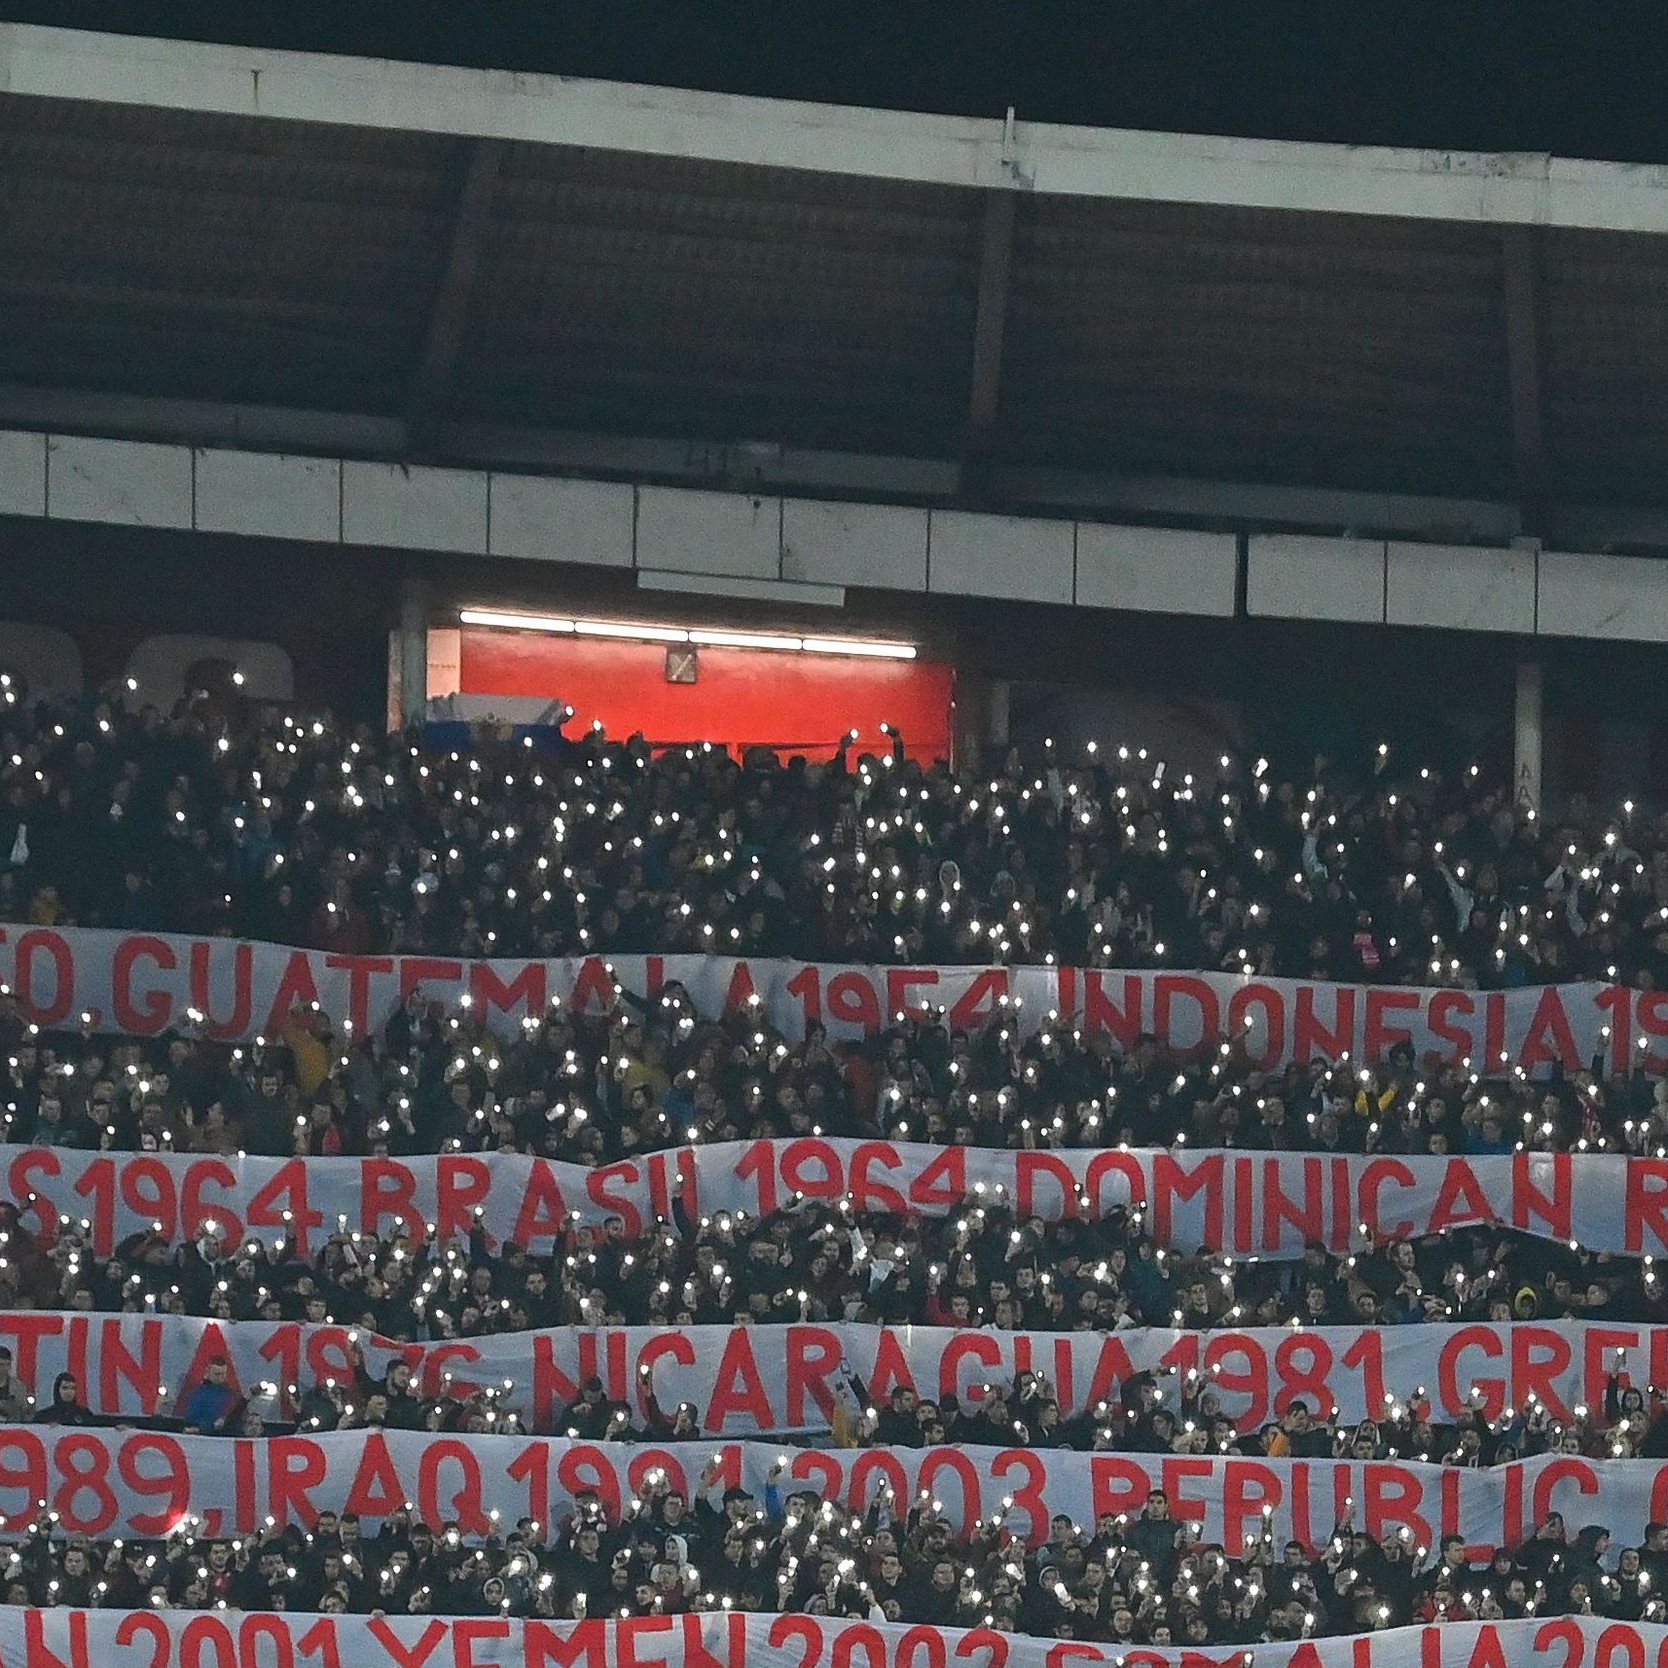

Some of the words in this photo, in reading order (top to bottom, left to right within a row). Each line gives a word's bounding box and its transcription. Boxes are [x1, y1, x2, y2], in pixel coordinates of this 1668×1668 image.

[1015, 1150, 1572, 1254] DOMINICAN
[234, 1432, 489, 1537] IRAQ
[1089, 1457, 1600, 1564] REPUBLIC
